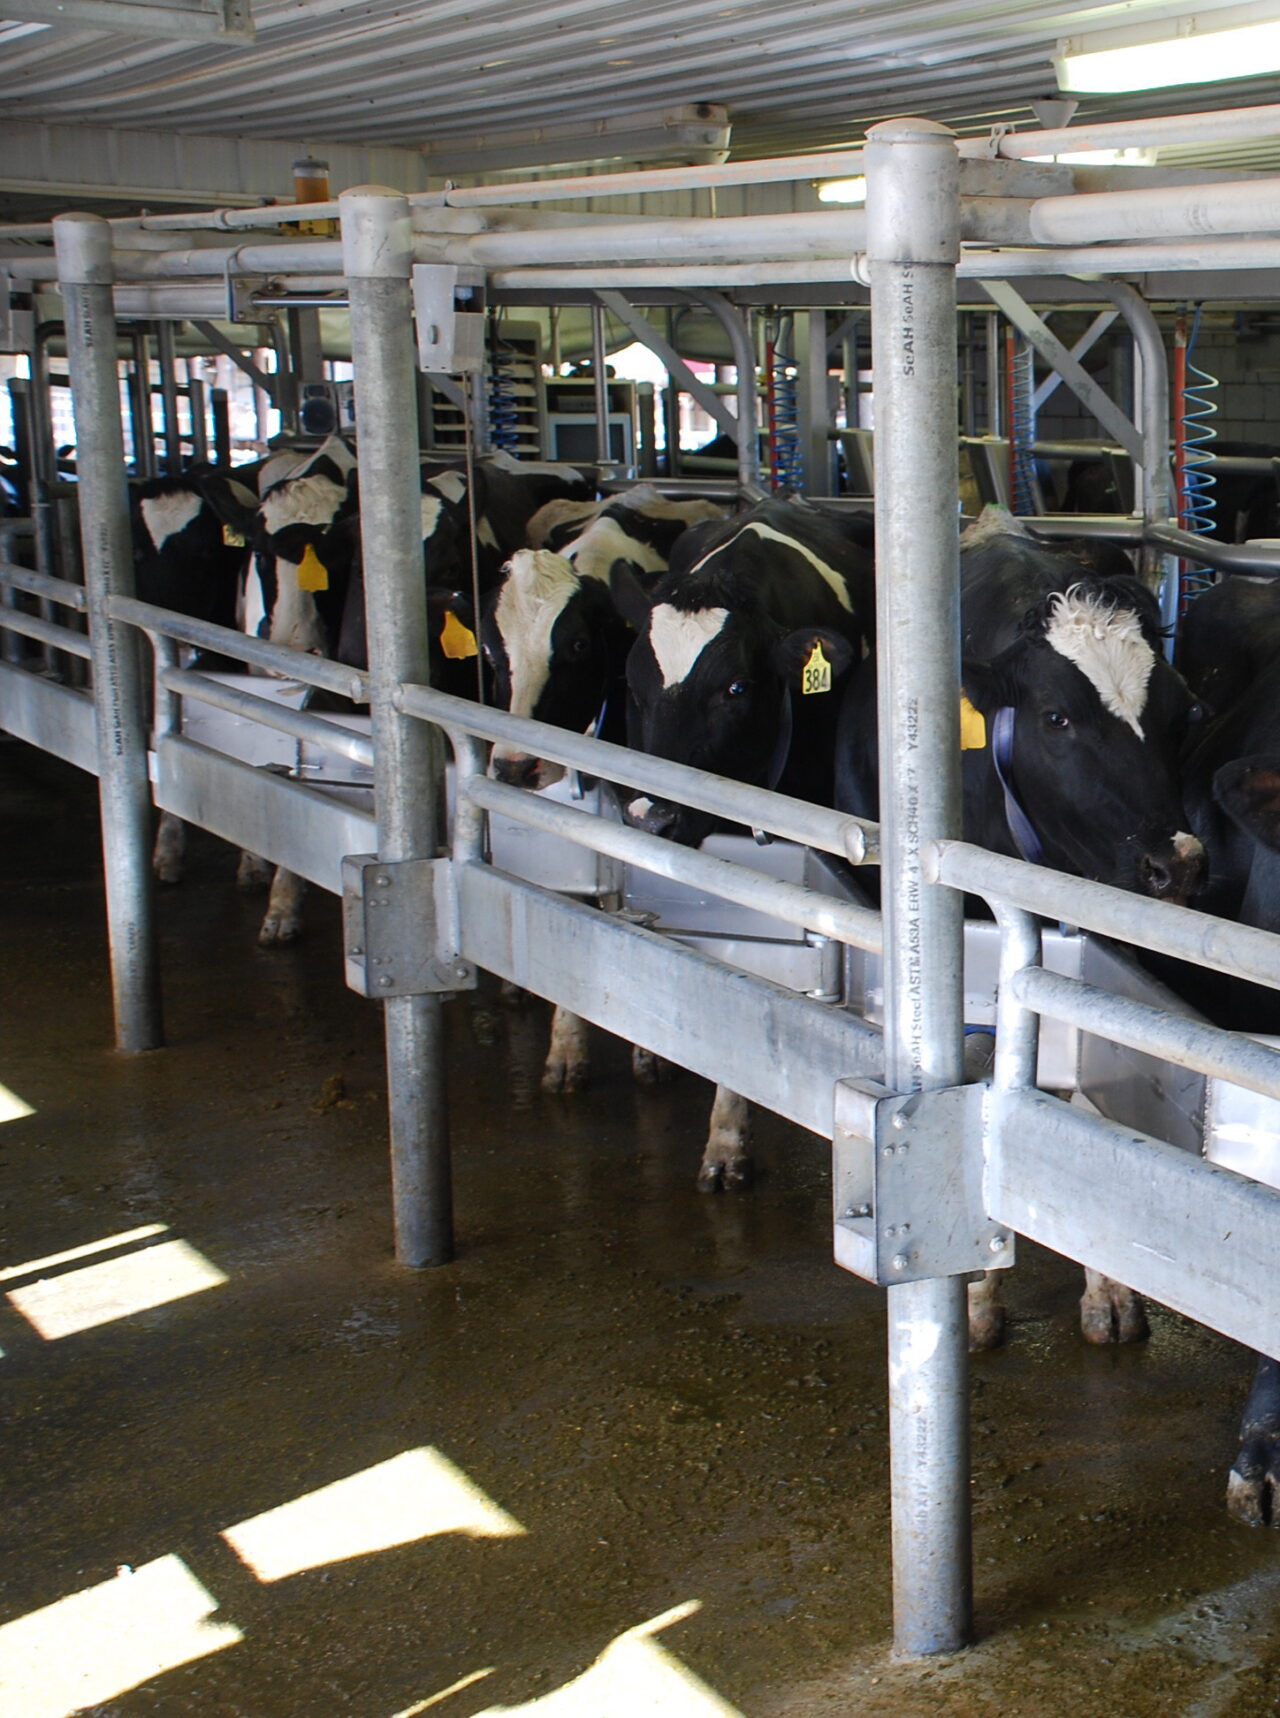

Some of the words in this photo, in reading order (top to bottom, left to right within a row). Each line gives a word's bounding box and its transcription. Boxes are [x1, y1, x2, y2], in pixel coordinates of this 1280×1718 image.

[902, 284, 914, 323] SeAH
[903, 327, 915, 376] SeAH
[805, 667, 828, 692] 384
[907, 796, 919, 844] SCH40
[908, 848, 919, 856] X
[908, 880, 919, 911] ERW
[911, 1036, 922, 1071] SeAH
